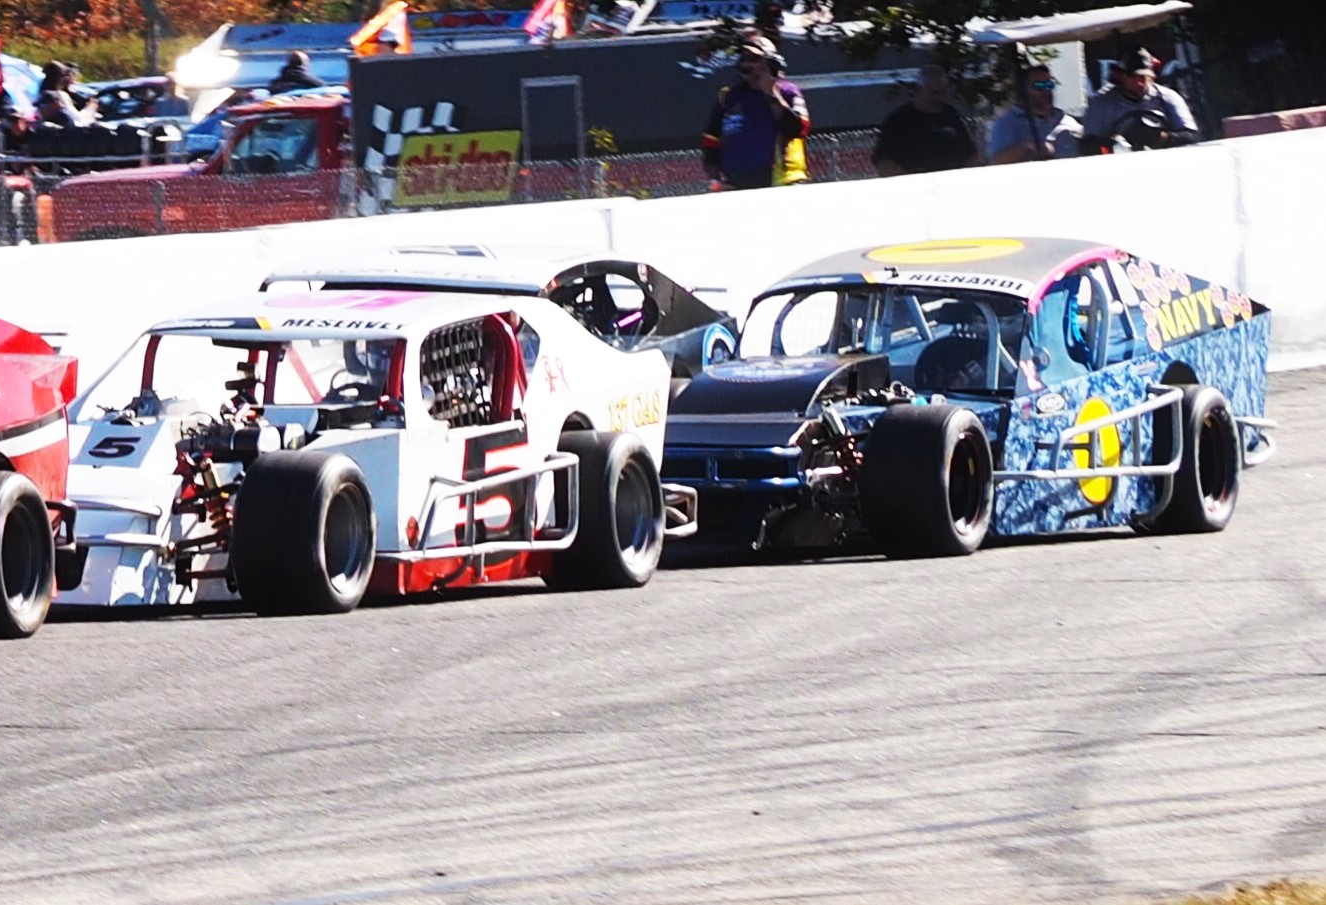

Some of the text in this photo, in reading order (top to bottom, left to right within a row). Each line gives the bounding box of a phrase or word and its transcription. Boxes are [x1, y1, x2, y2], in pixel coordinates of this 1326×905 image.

[1155, 288, 1216, 342] NAVY
[88, 436, 142, 459] 5
[454, 426, 535, 568] 5
